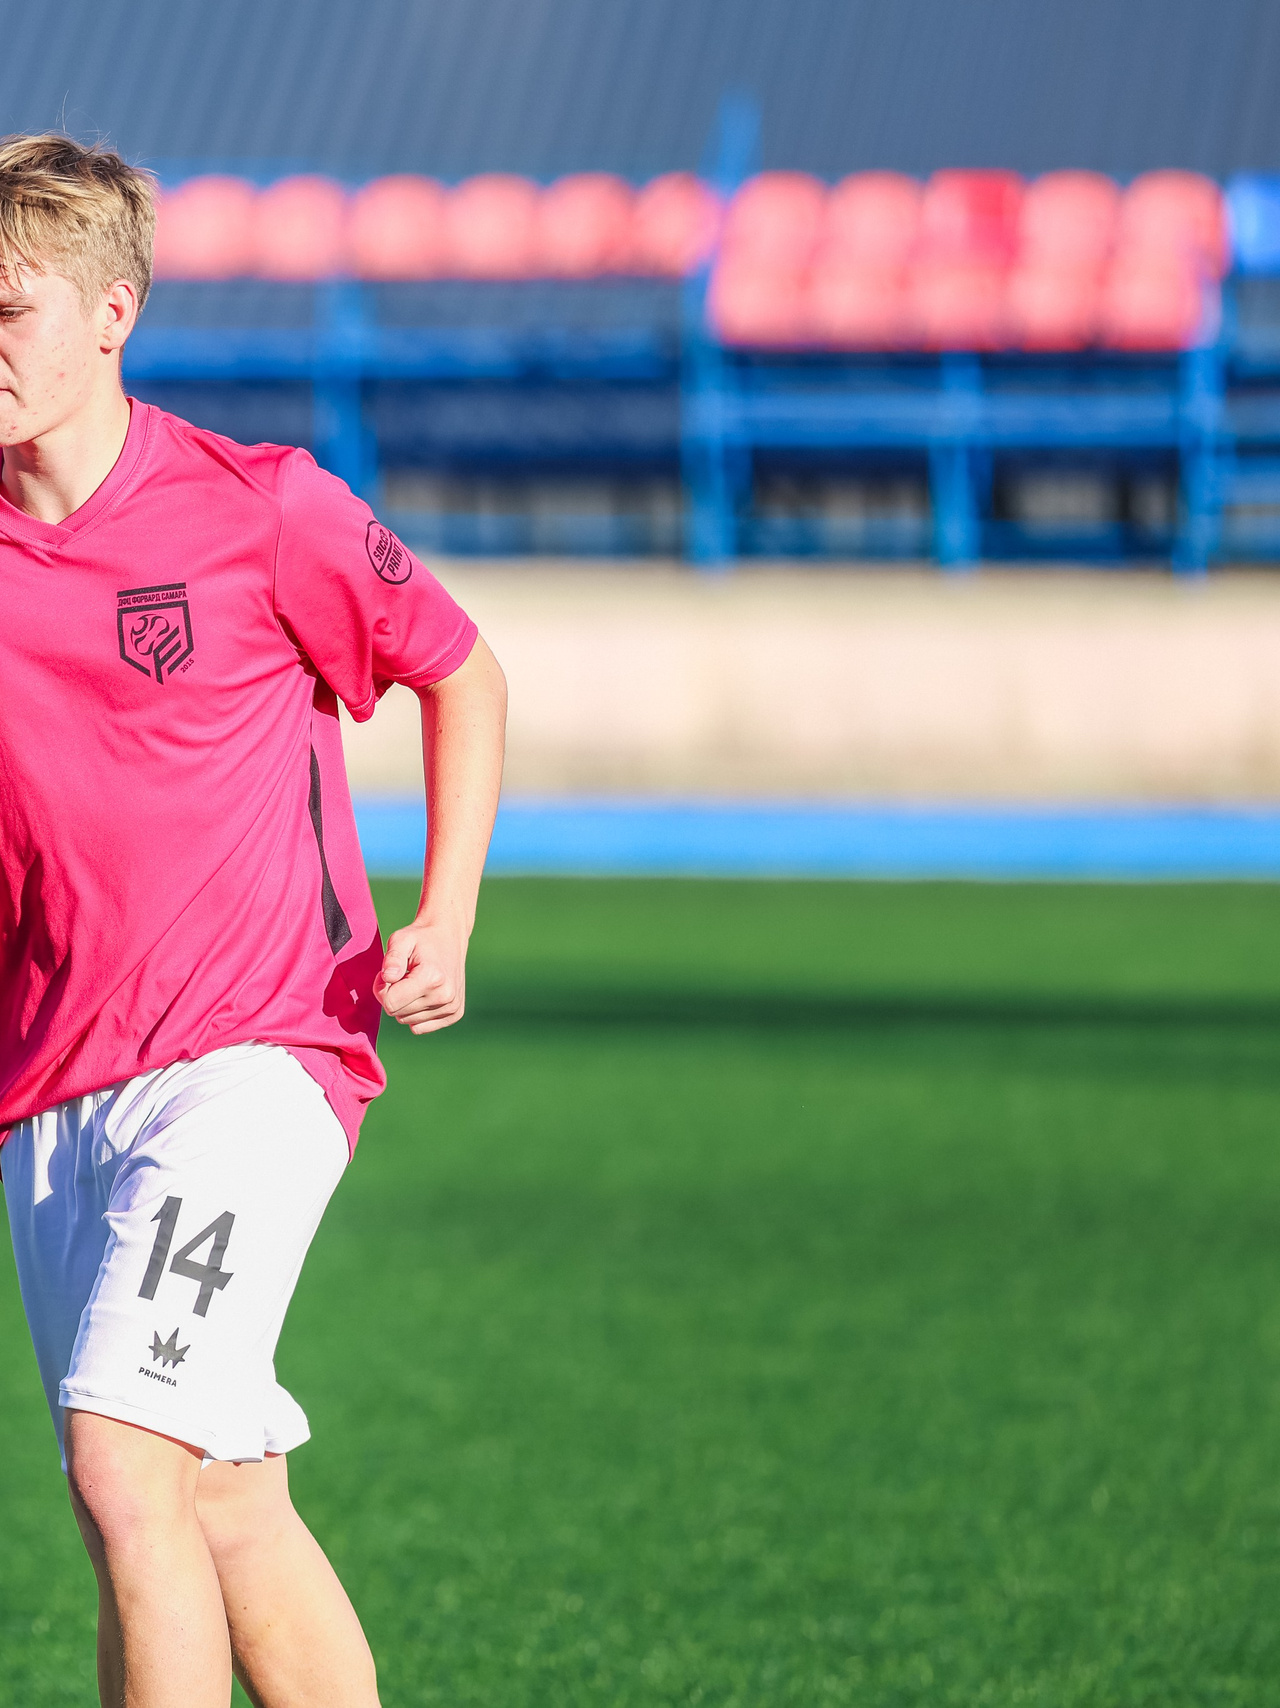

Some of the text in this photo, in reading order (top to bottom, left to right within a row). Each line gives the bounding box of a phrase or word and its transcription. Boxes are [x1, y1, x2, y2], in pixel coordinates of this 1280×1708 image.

[386, 542, 403, 577] PRINT
[132, 594, 161, 604] ФОРВАРД
[161, 590, 187, 601] САМАРА
[180, 658, 195, 673] 2015
[137, 1196, 235, 1318] 14
[138, 1366, 177, 1387] PRIMERA
